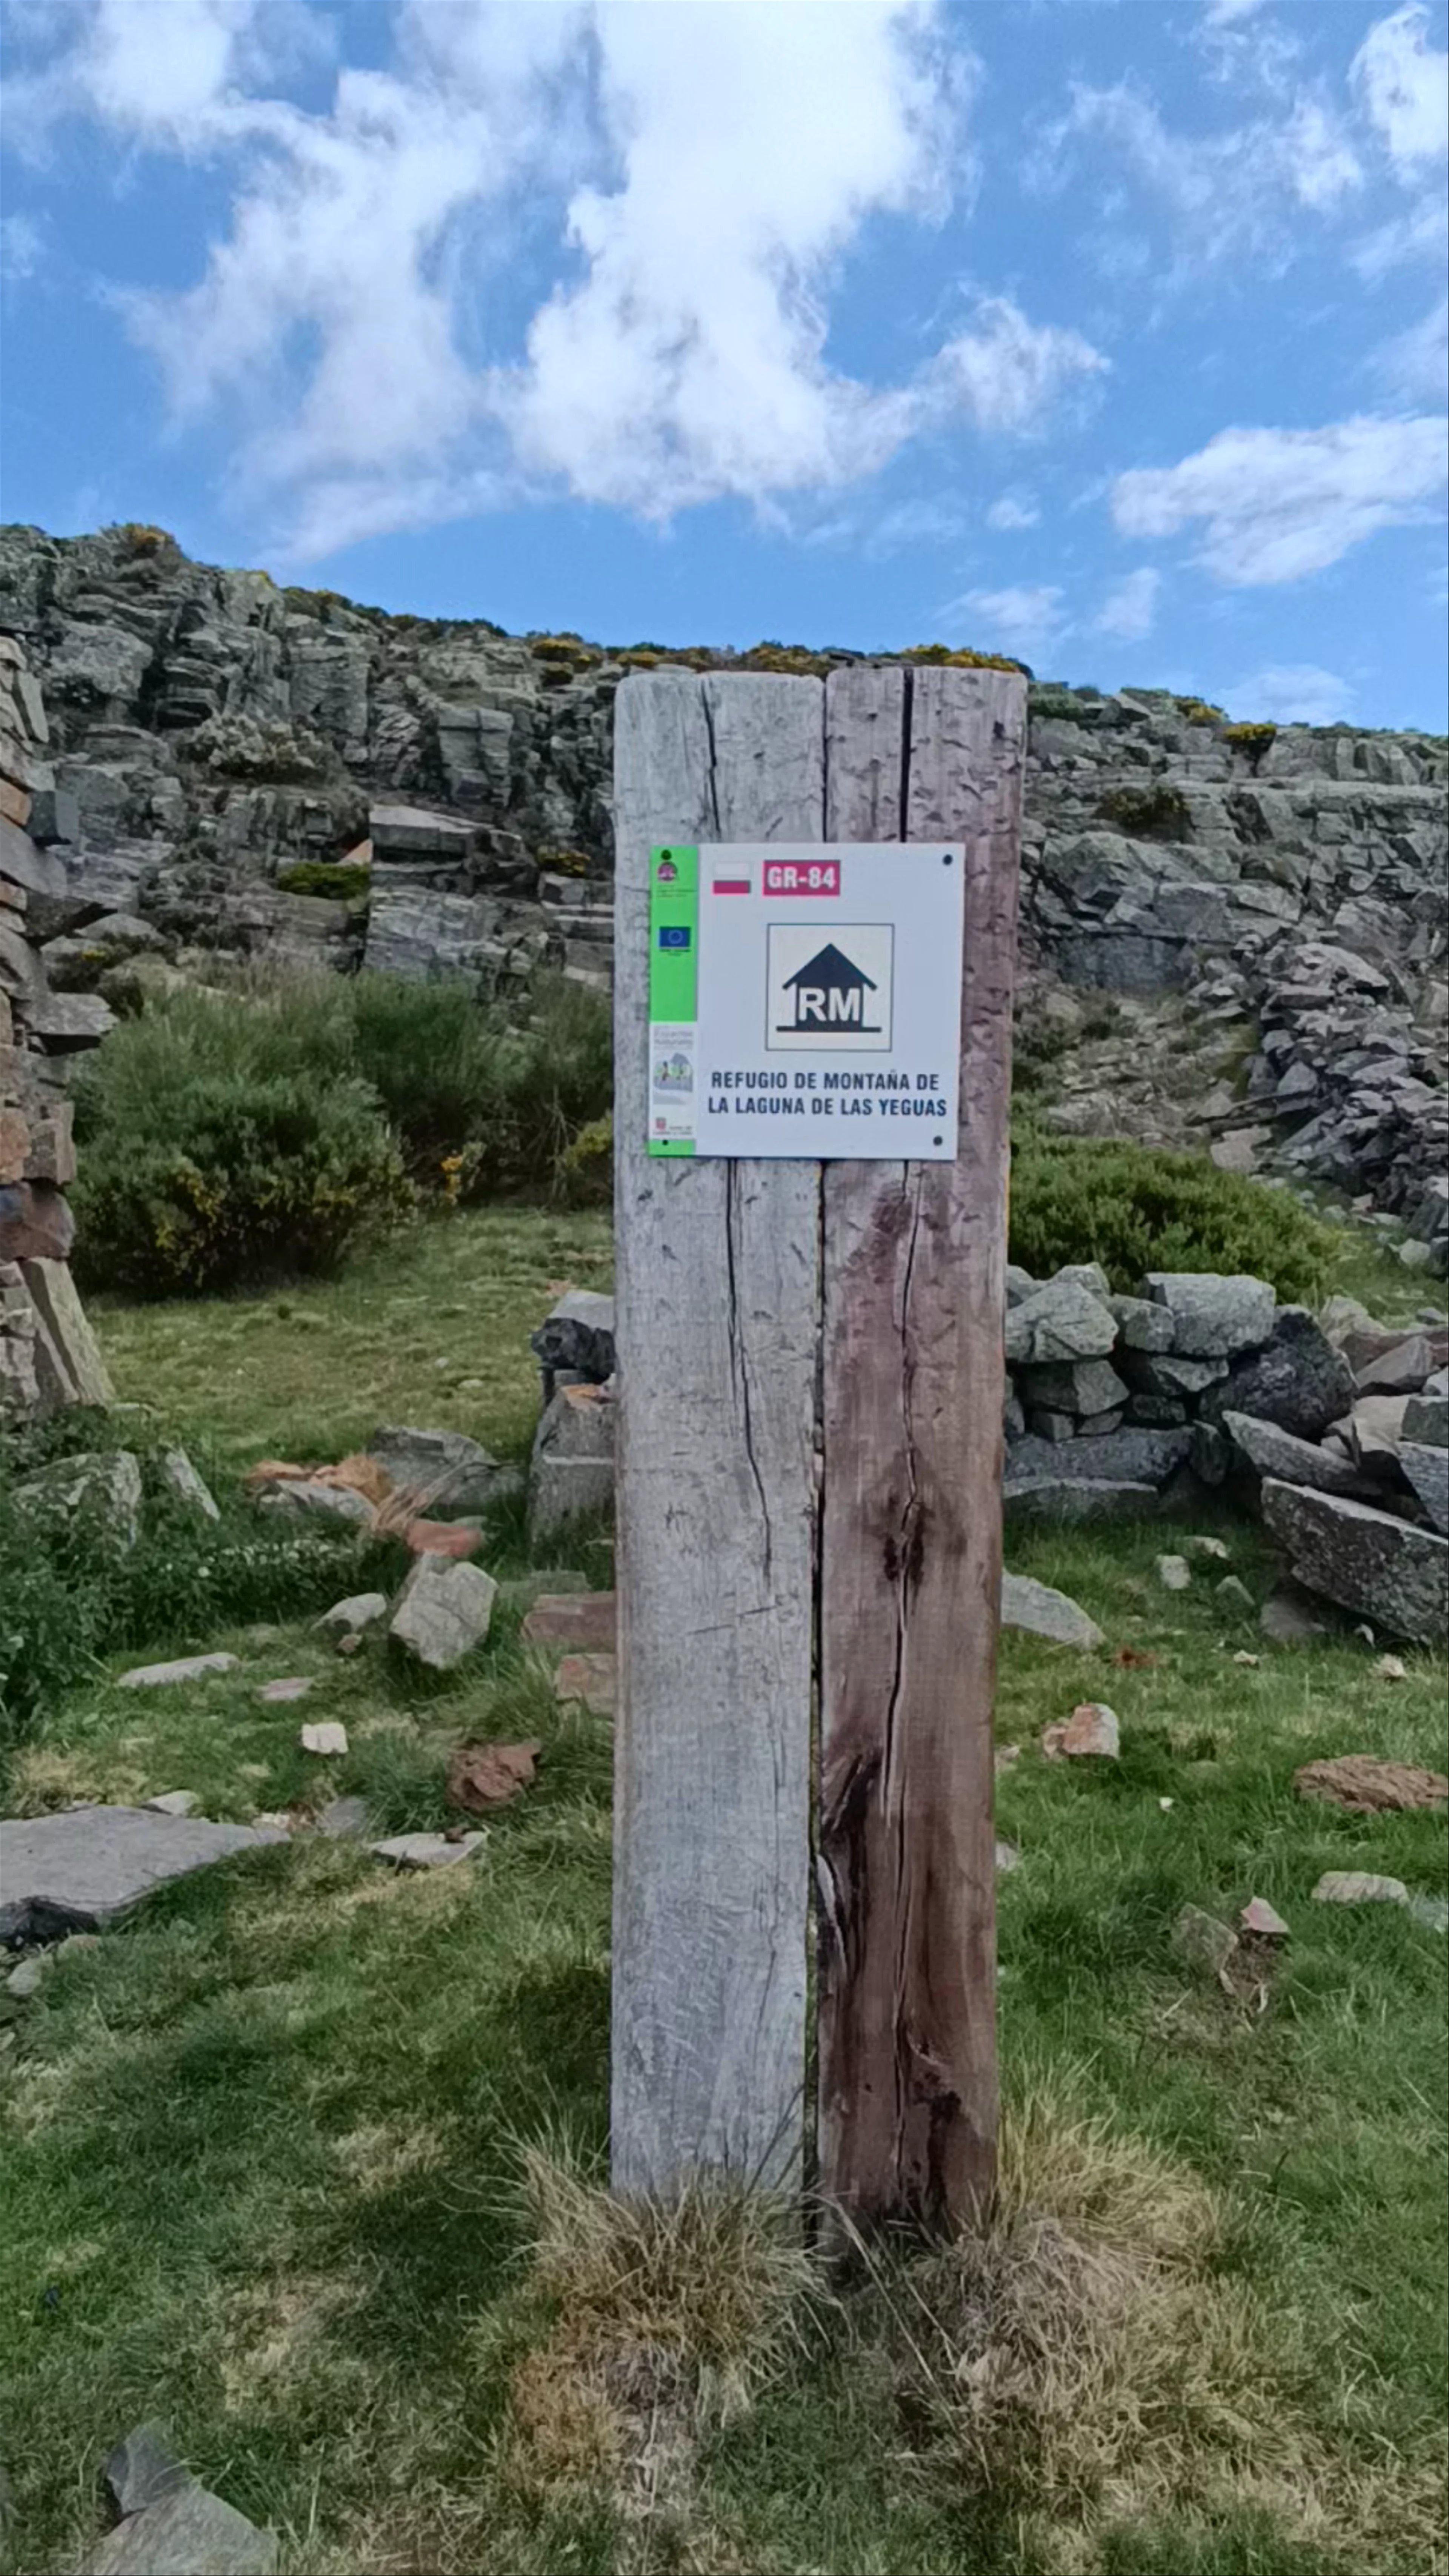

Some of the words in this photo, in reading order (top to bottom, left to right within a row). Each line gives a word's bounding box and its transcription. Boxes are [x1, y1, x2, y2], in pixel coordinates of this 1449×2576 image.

[767, 867, 836, 889] GR-84
[798, 987, 860, 1021] RM
[712, 1072, 787, 1089] REFUGIO
[795, 1072, 816, 1089] DE
[824, 1069, 910, 1090] MONTAÑA
[917, 1073, 939, 1091] DE
[708, 1097, 728, 1113] LA
[735, 1097, 805, 1115] LAGUNA
[812, 1098, 833, 1115] DE
[841, 1098, 872, 1115] LAS
[879, 1099, 947, 1117] YEGUAS
